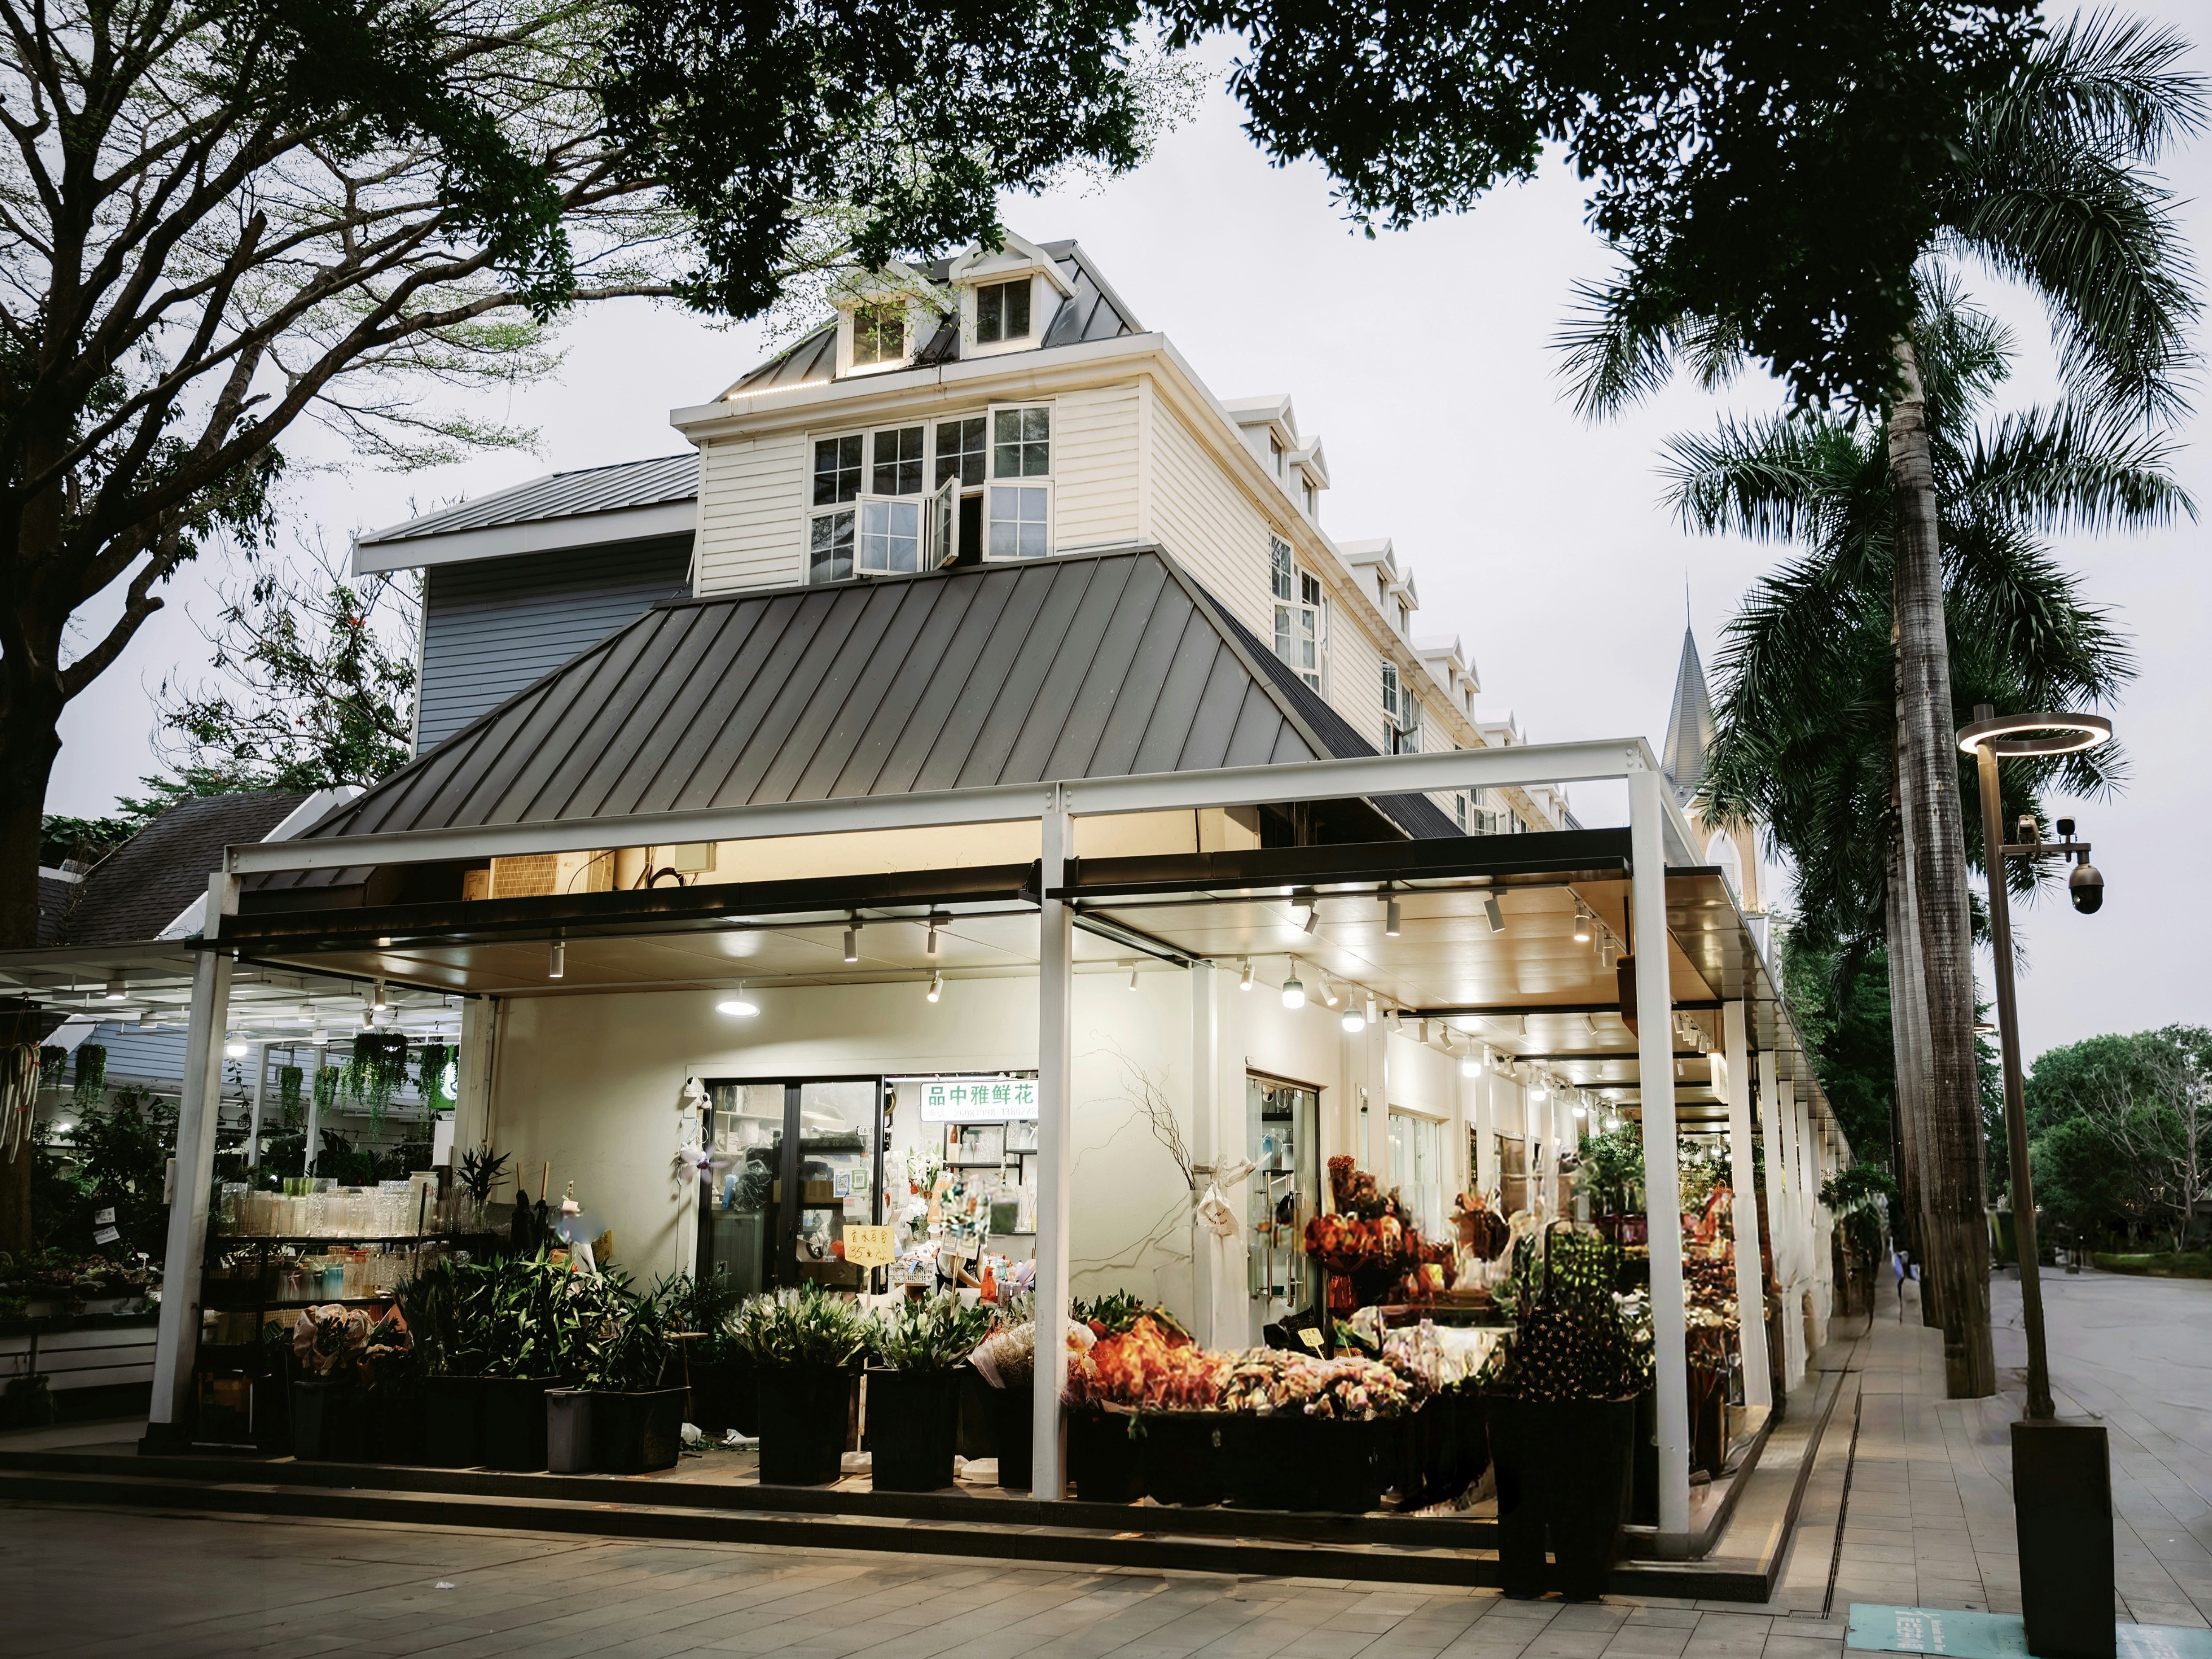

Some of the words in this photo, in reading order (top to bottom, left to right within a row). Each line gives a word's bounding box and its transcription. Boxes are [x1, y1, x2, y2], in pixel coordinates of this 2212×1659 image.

[929, 1084, 1033, 1106] 品中雅鲜花
[1002, 1107, 1038, 1116] 1380228
